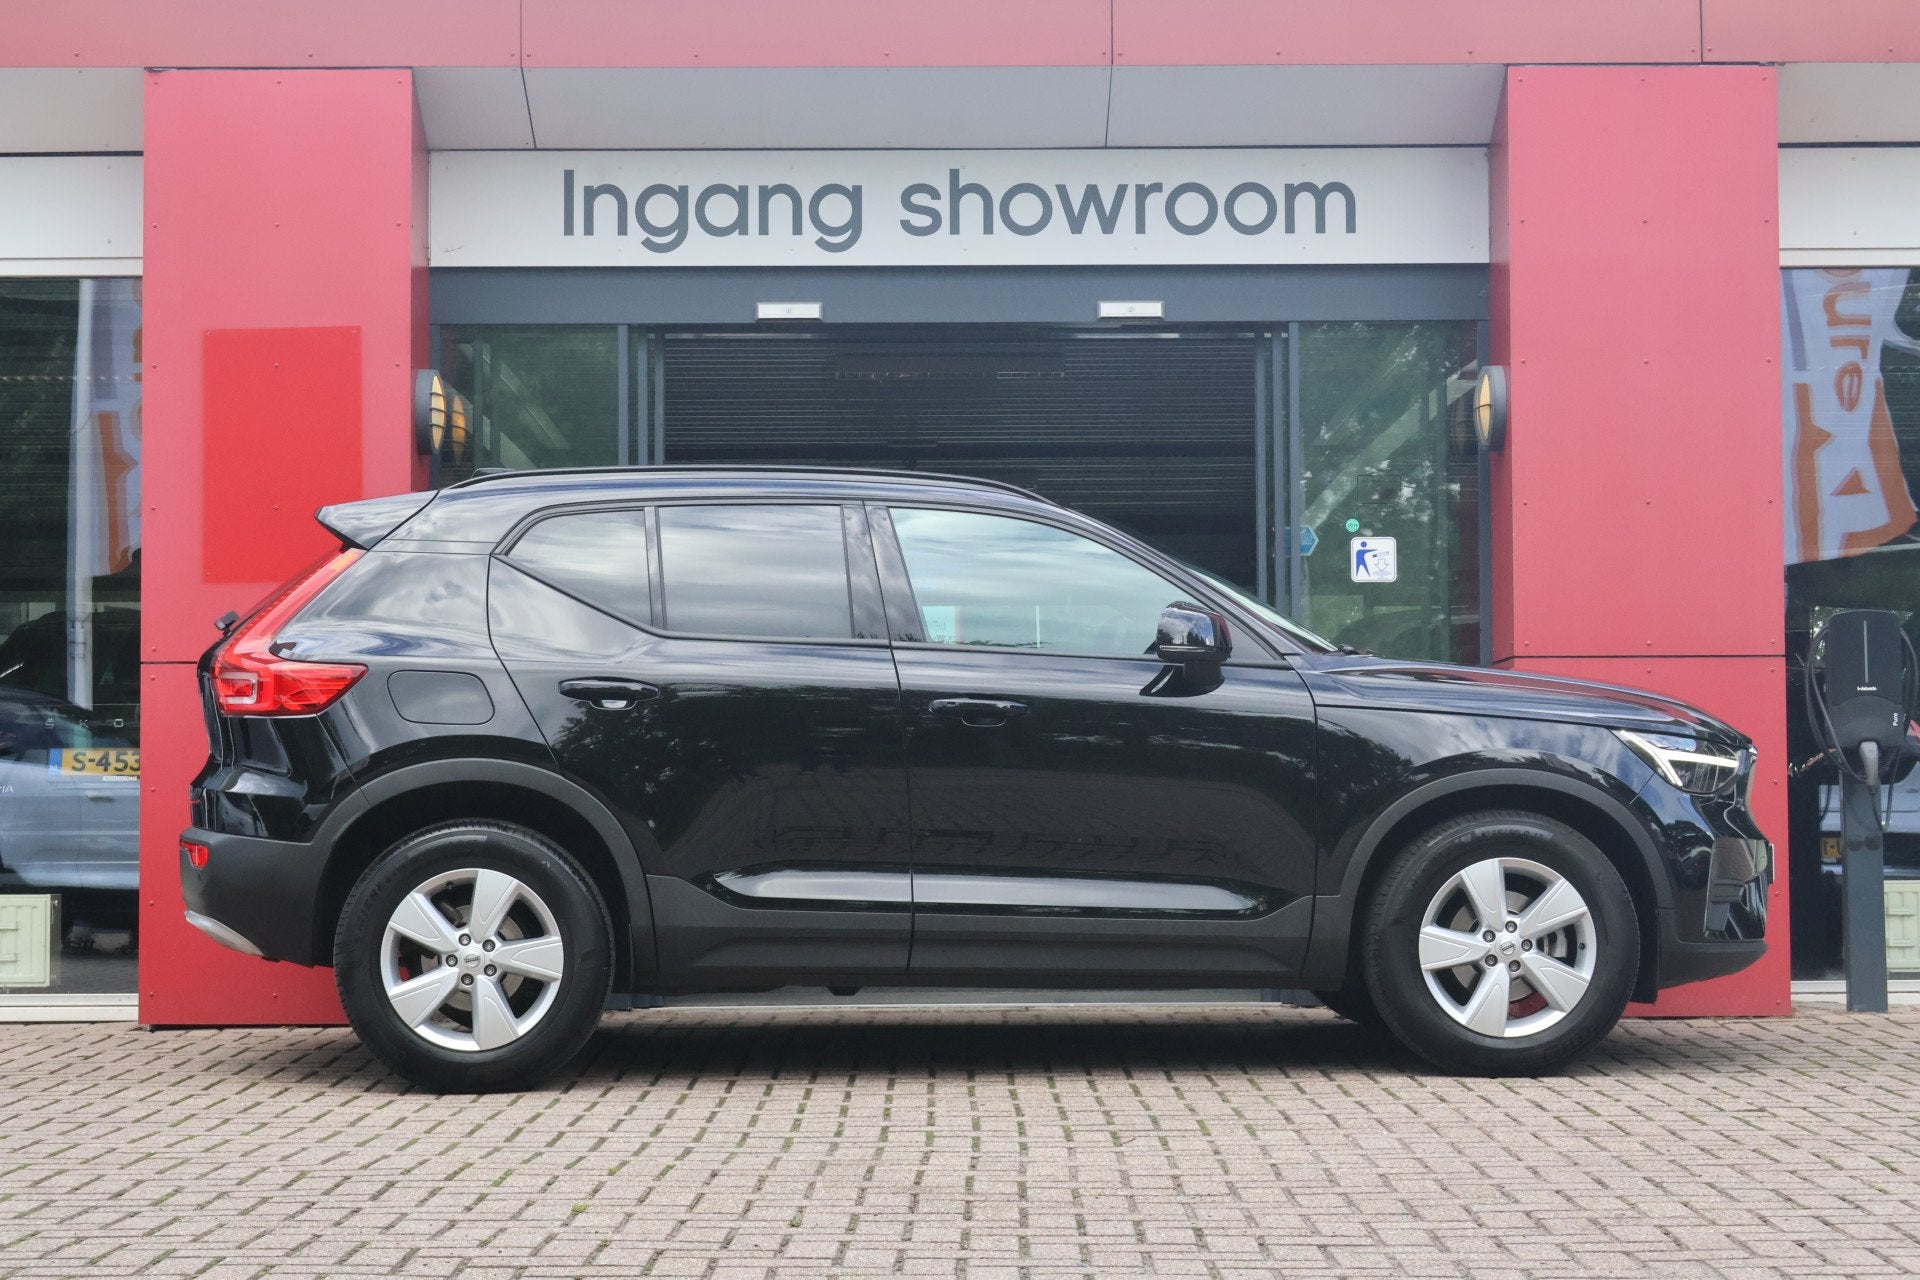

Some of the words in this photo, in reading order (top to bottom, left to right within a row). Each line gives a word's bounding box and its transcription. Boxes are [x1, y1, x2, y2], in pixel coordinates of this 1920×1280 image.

[563, 168, 863, 254] Ingang
[899, 168, 1357, 237] showroom
[72, 751, 140, 772] S-453
